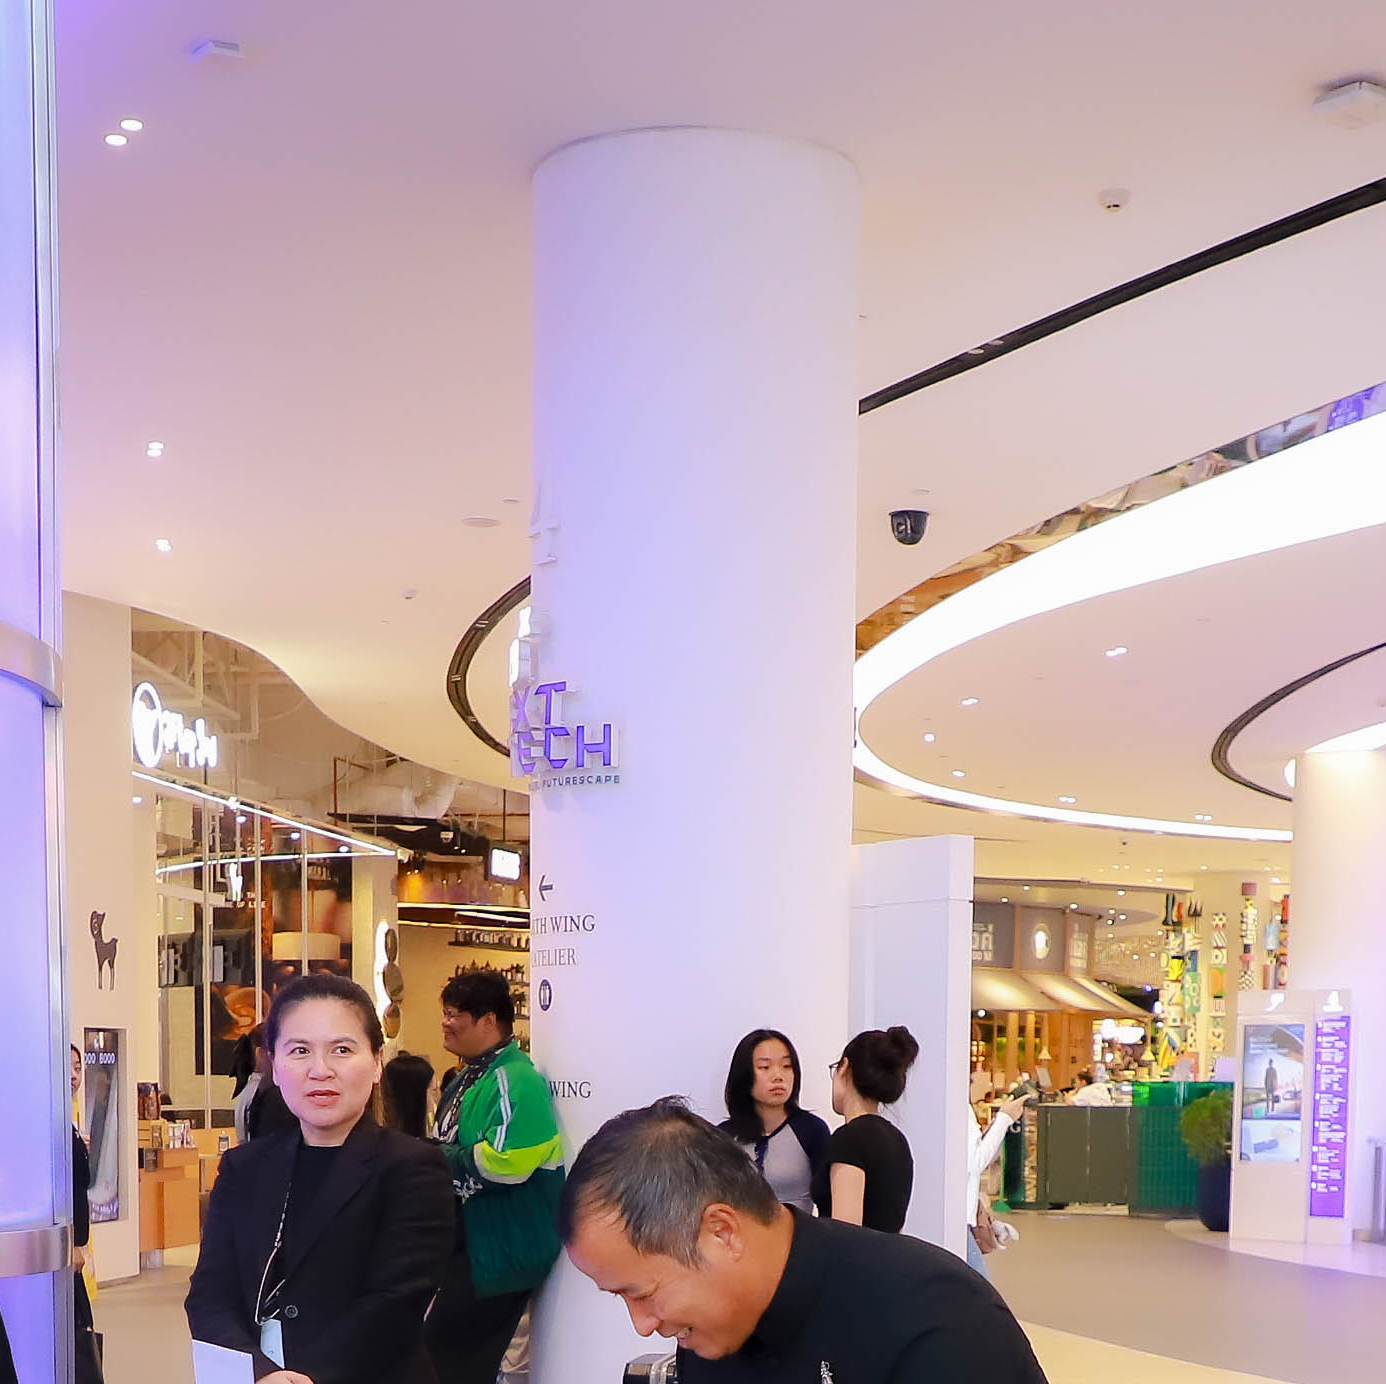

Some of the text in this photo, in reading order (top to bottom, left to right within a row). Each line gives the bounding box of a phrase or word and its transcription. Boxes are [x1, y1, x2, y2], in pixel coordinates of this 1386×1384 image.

[550, 914, 596, 934] WING
[532, 948, 577, 968] ATELIER
[549, 1080, 592, 1098] WING
